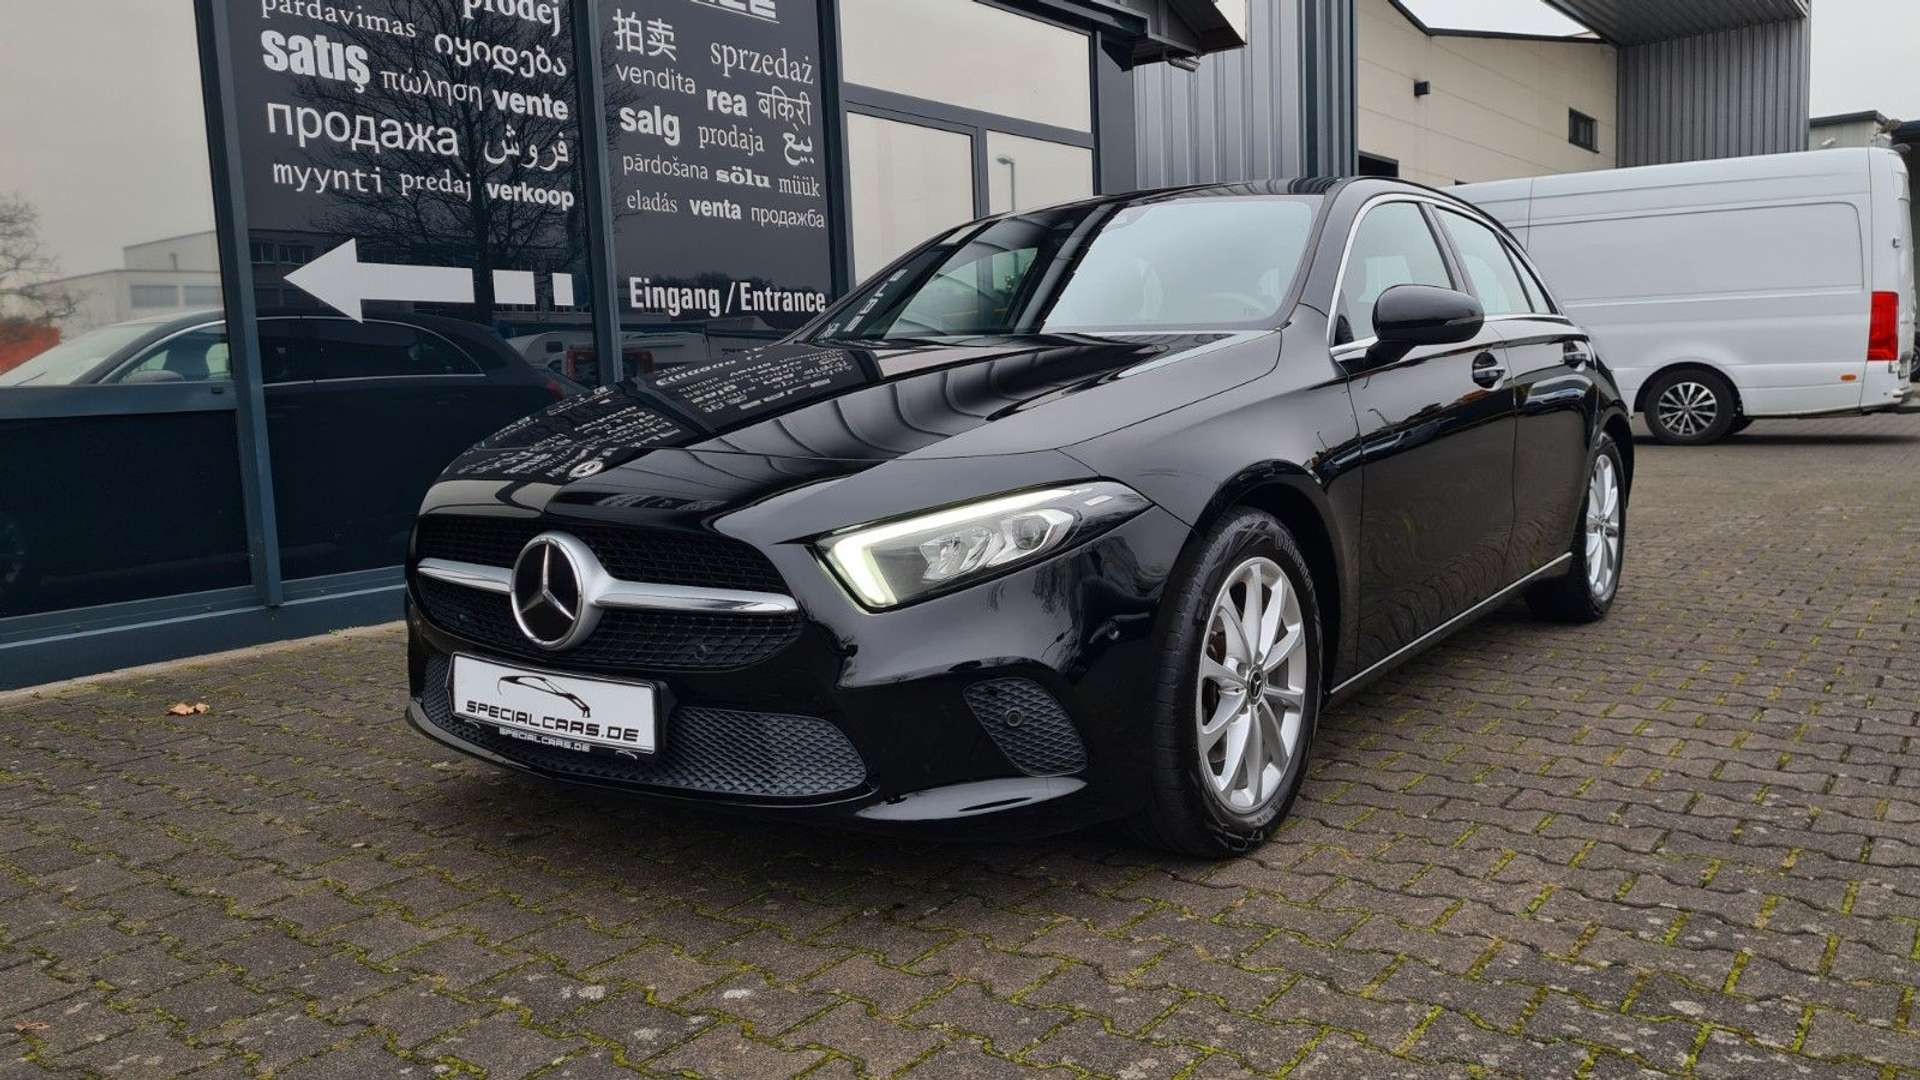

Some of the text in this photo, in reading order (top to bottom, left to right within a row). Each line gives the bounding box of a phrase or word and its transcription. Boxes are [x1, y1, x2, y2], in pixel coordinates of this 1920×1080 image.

[261, 0, 416, 38] pardavimas
[612, 8, 677, 61] 拍卖
[261, 30, 370, 93] satış
[434, 33, 567, 78] იყიდება
[710, 42, 813, 85] sprzedaż
[380, 67, 482, 111] πώληση
[615, 63, 696, 94] vendita
[492, 89, 569, 120] vente
[706, 88, 748, 117] rea
[267, 102, 459, 156] продажа
[619, 105, 681, 146] salg
[697, 124, 765, 157] prodaja
[484, 123, 569, 171] فروش
[273, 162, 382, 193] myynti
[623, 154, 708, 180] pārdošana
[716, 165, 771, 188] sölu
[400, 170, 472, 201] predaj
[486, 182, 574, 211] verkoop
[627, 189, 678, 213] eladás
[778, 175, 820, 197] müük
[689, 199, 742, 220] venta
[751, 206, 825, 228] продажба
[629, 276, 720, 317] Eingang
[740, 282, 826, 313] Entrance
[466, 700, 641, 742] SPECIALCARS.DE
